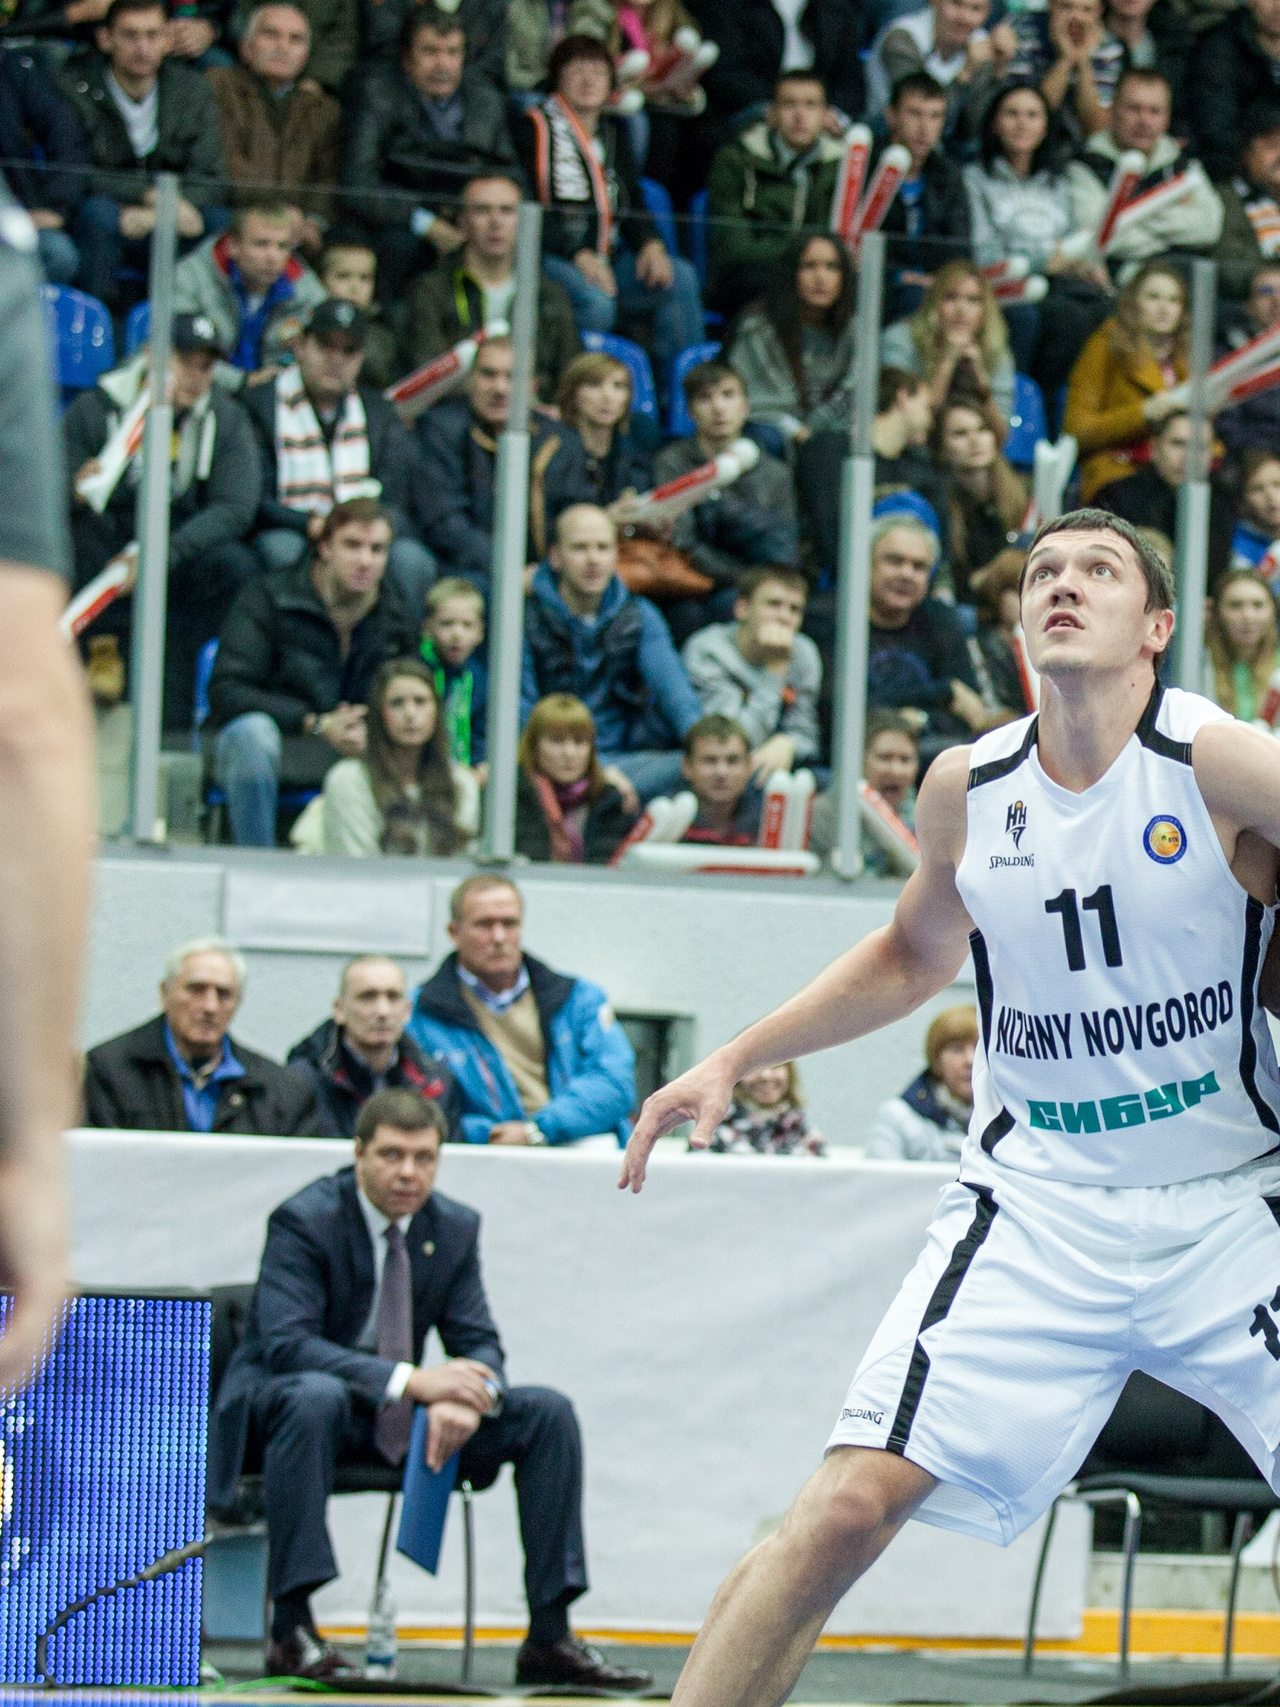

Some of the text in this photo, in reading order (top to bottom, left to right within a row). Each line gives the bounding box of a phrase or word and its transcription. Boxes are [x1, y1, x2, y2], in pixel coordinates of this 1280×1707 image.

[989, 853, 1035, 870] SPALDING
[1045, 884, 1123, 972] 11
[996, 980, 1233, 1061] NIZHNY NOVGOROD
[1025, 1070, 1221, 1134] СИБУР
